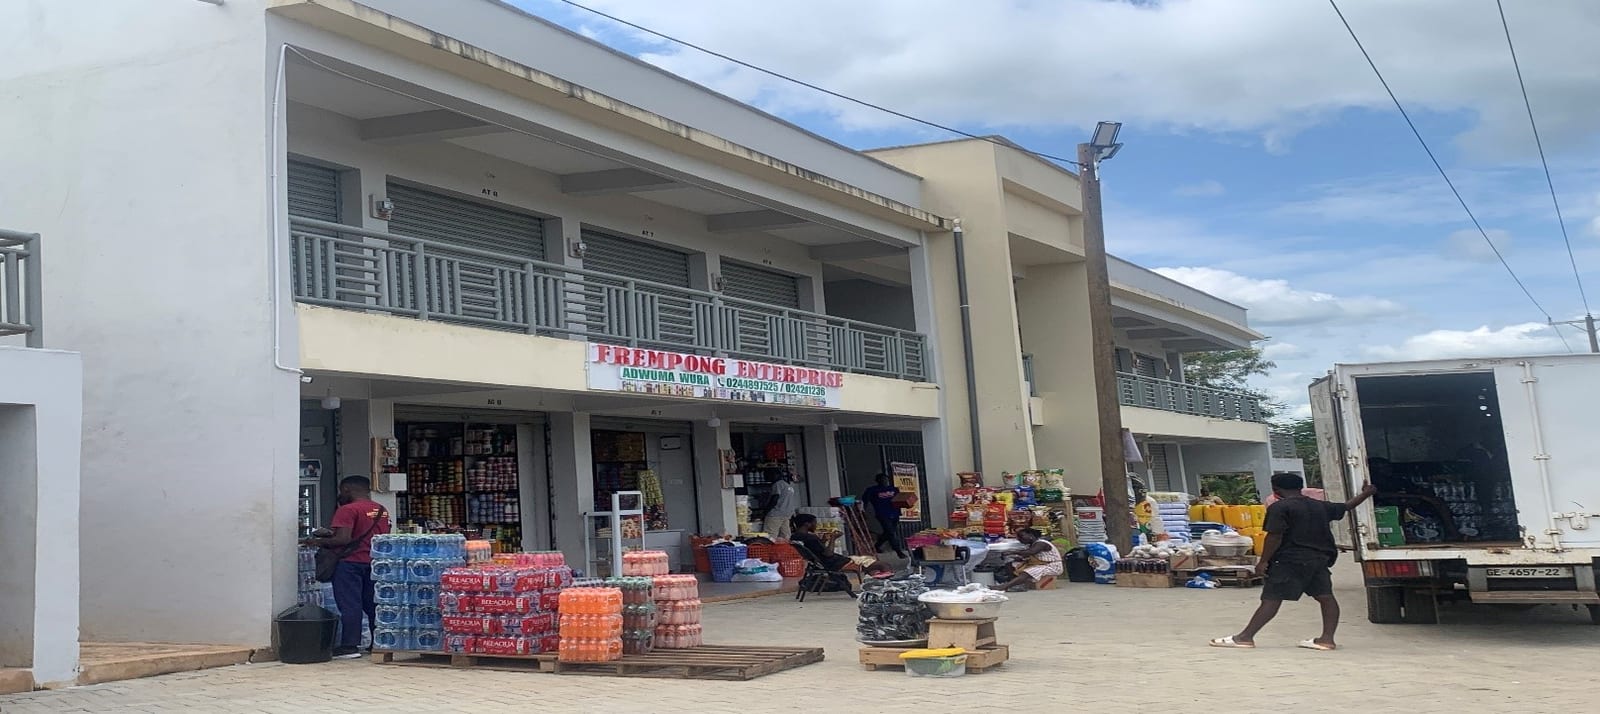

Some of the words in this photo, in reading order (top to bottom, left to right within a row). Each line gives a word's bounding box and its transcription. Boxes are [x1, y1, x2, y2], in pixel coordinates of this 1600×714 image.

[592, 344, 726, 375] FREMPONG
[737, 361, 844, 388] ENTERPRISE
[622, 368, 676, 382] ADWUMA
[679, 373, 710, 385] WURA
[726, 378, 779, 391] 0244897525
